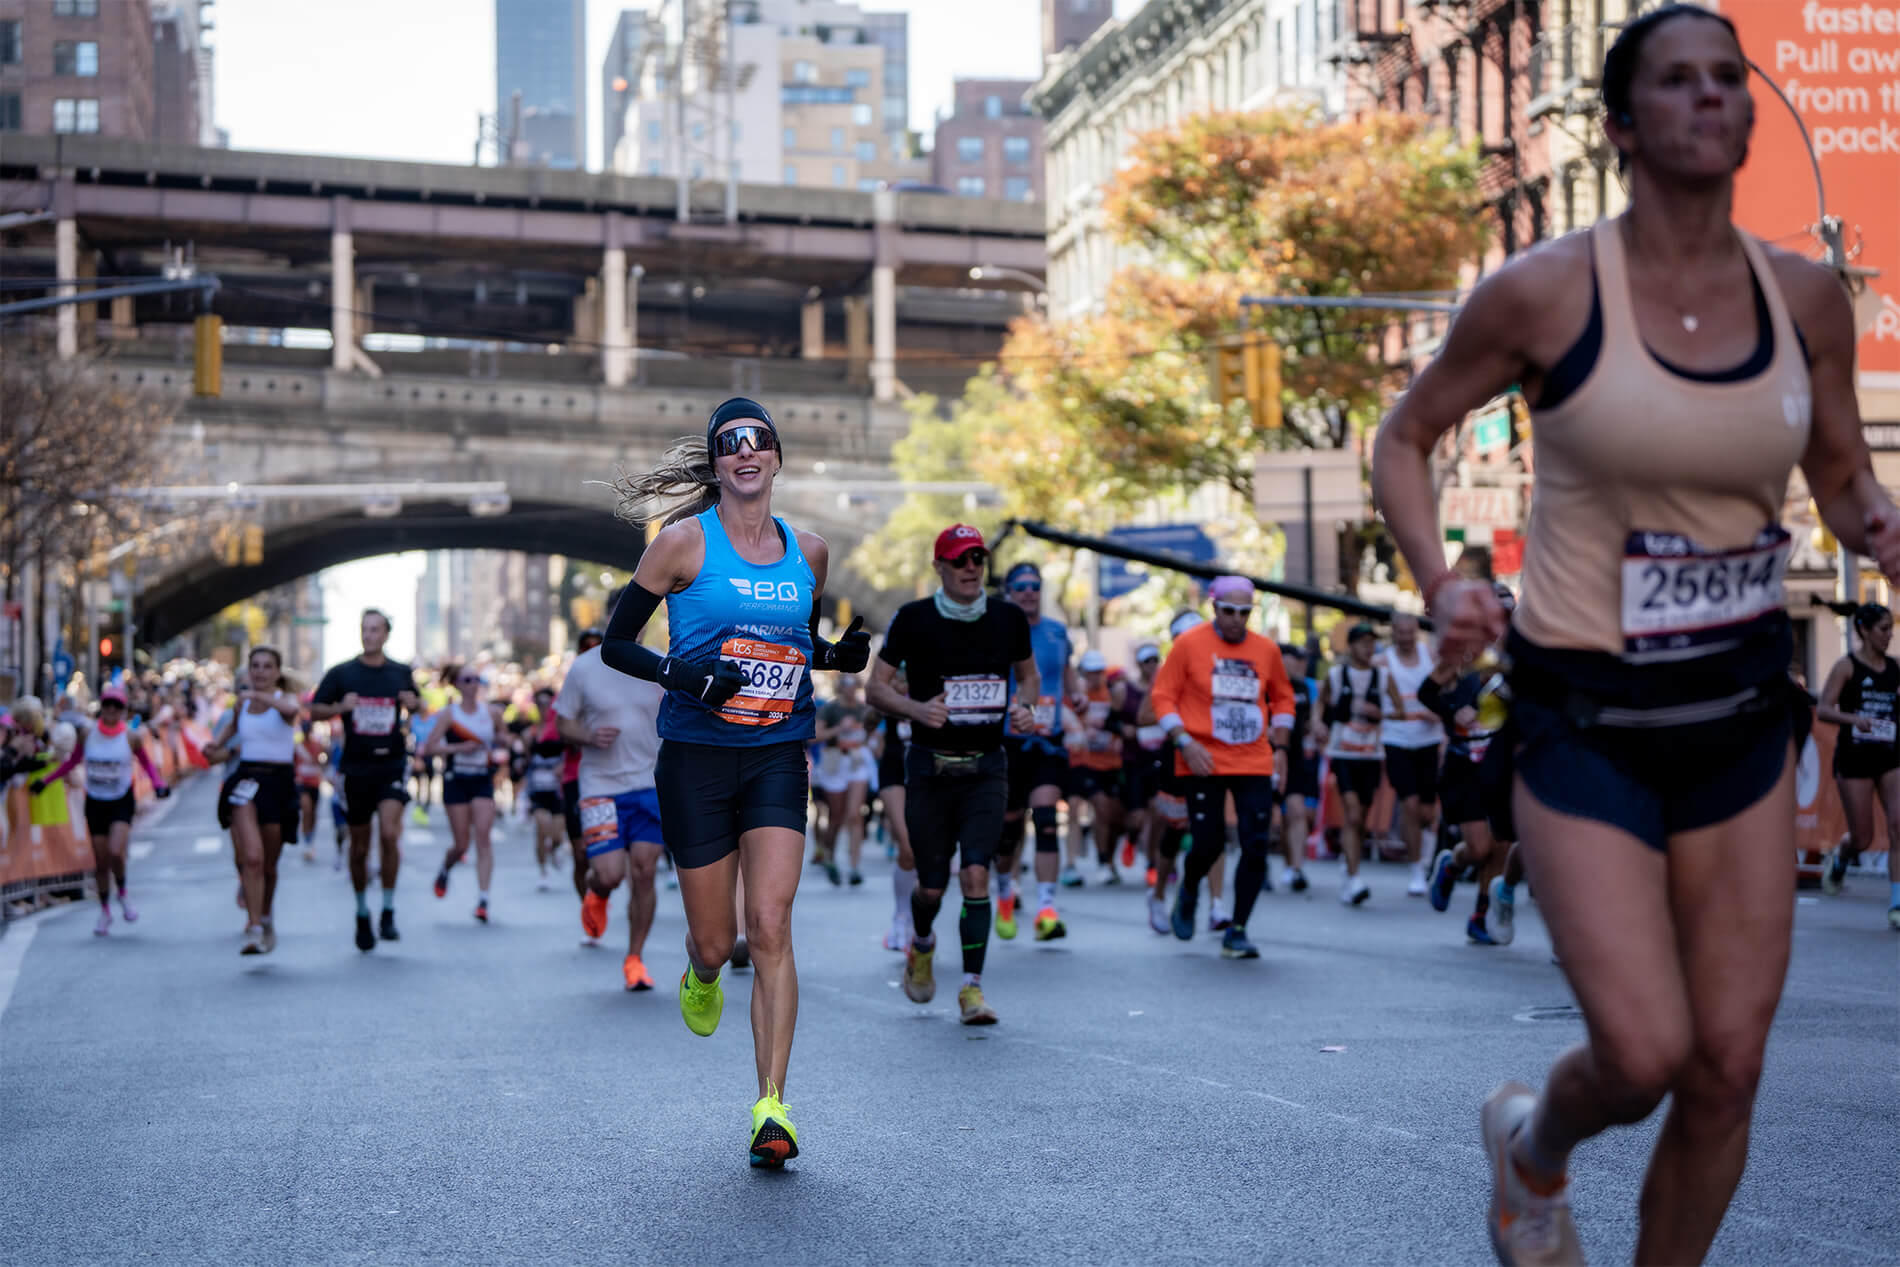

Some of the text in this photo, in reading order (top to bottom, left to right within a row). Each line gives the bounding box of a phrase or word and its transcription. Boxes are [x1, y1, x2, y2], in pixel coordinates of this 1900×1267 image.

[1776, 39, 1839, 73] Pull
[1784, 78, 1870, 114] from
[1641, 555, 1775, 609] 25614
[739, 602, 801, 613] PERFORMANCE
[735, 623, 793, 636] MARINA
[733, 639, 753, 655] tcs
[952, 682, 1001, 701] 21327
